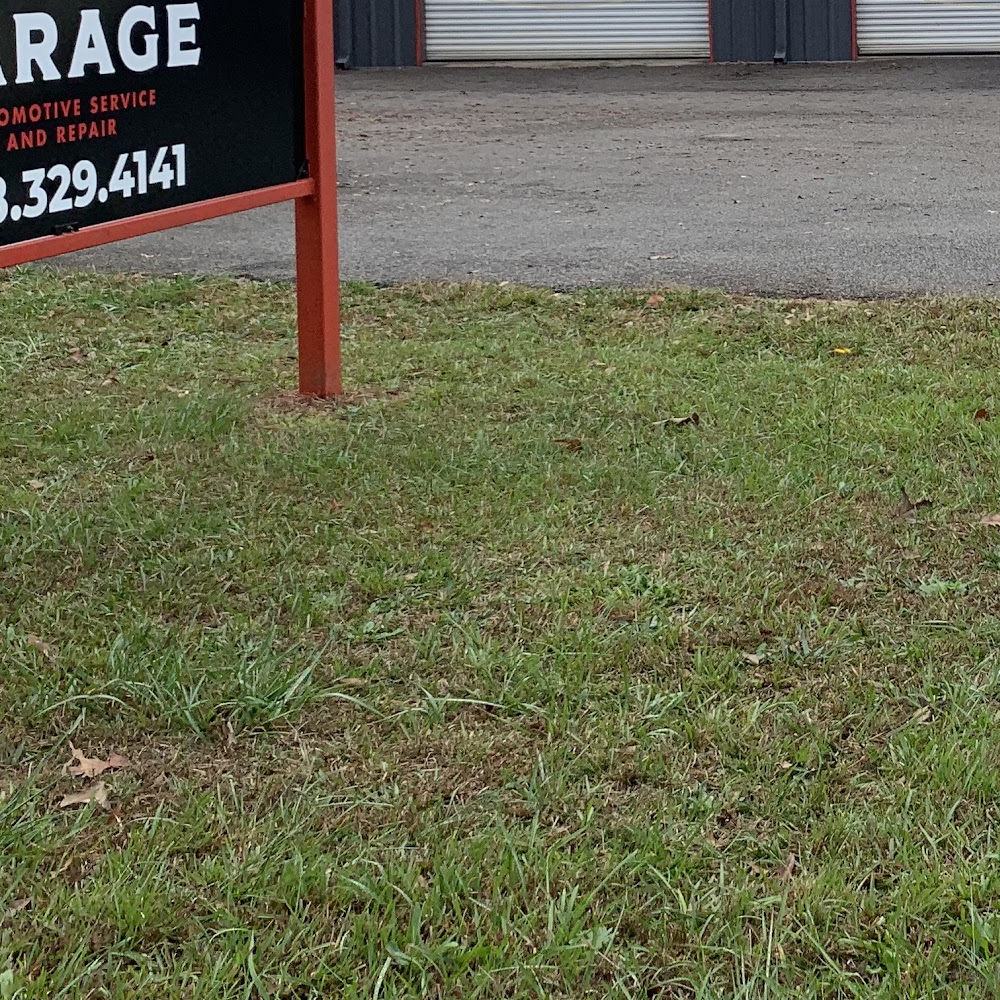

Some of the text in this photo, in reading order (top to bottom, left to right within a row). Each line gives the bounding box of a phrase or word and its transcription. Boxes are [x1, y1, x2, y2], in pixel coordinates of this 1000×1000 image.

[89, 89, 157, 114] SERVICE
[7, 118, 118, 151] AND REPAIR
